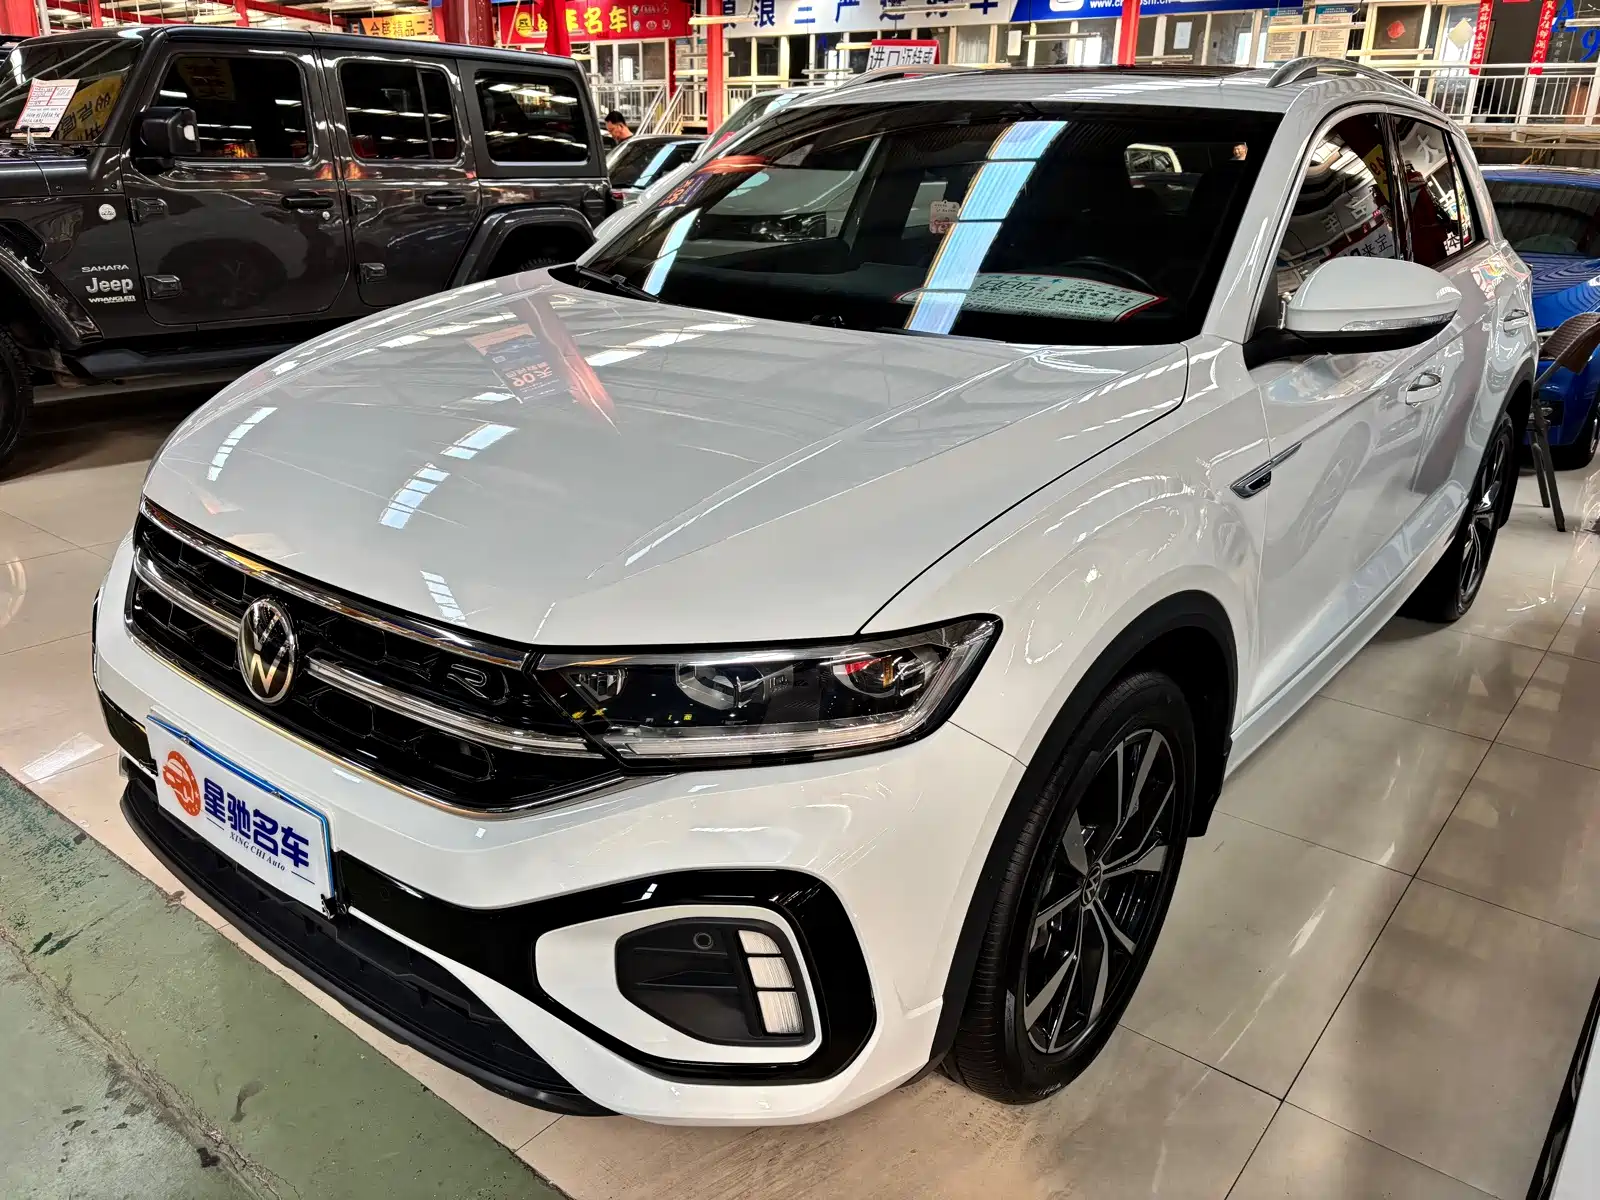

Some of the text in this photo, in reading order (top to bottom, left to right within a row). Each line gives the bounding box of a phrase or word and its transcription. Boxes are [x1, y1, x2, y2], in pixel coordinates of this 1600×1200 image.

[81, 264, 129, 273] SAHARA
[85, 277, 134, 294] Jeep
[203, 777, 310, 869] 星驰名车
[229, 831, 286, 872] XING CHI Auto
